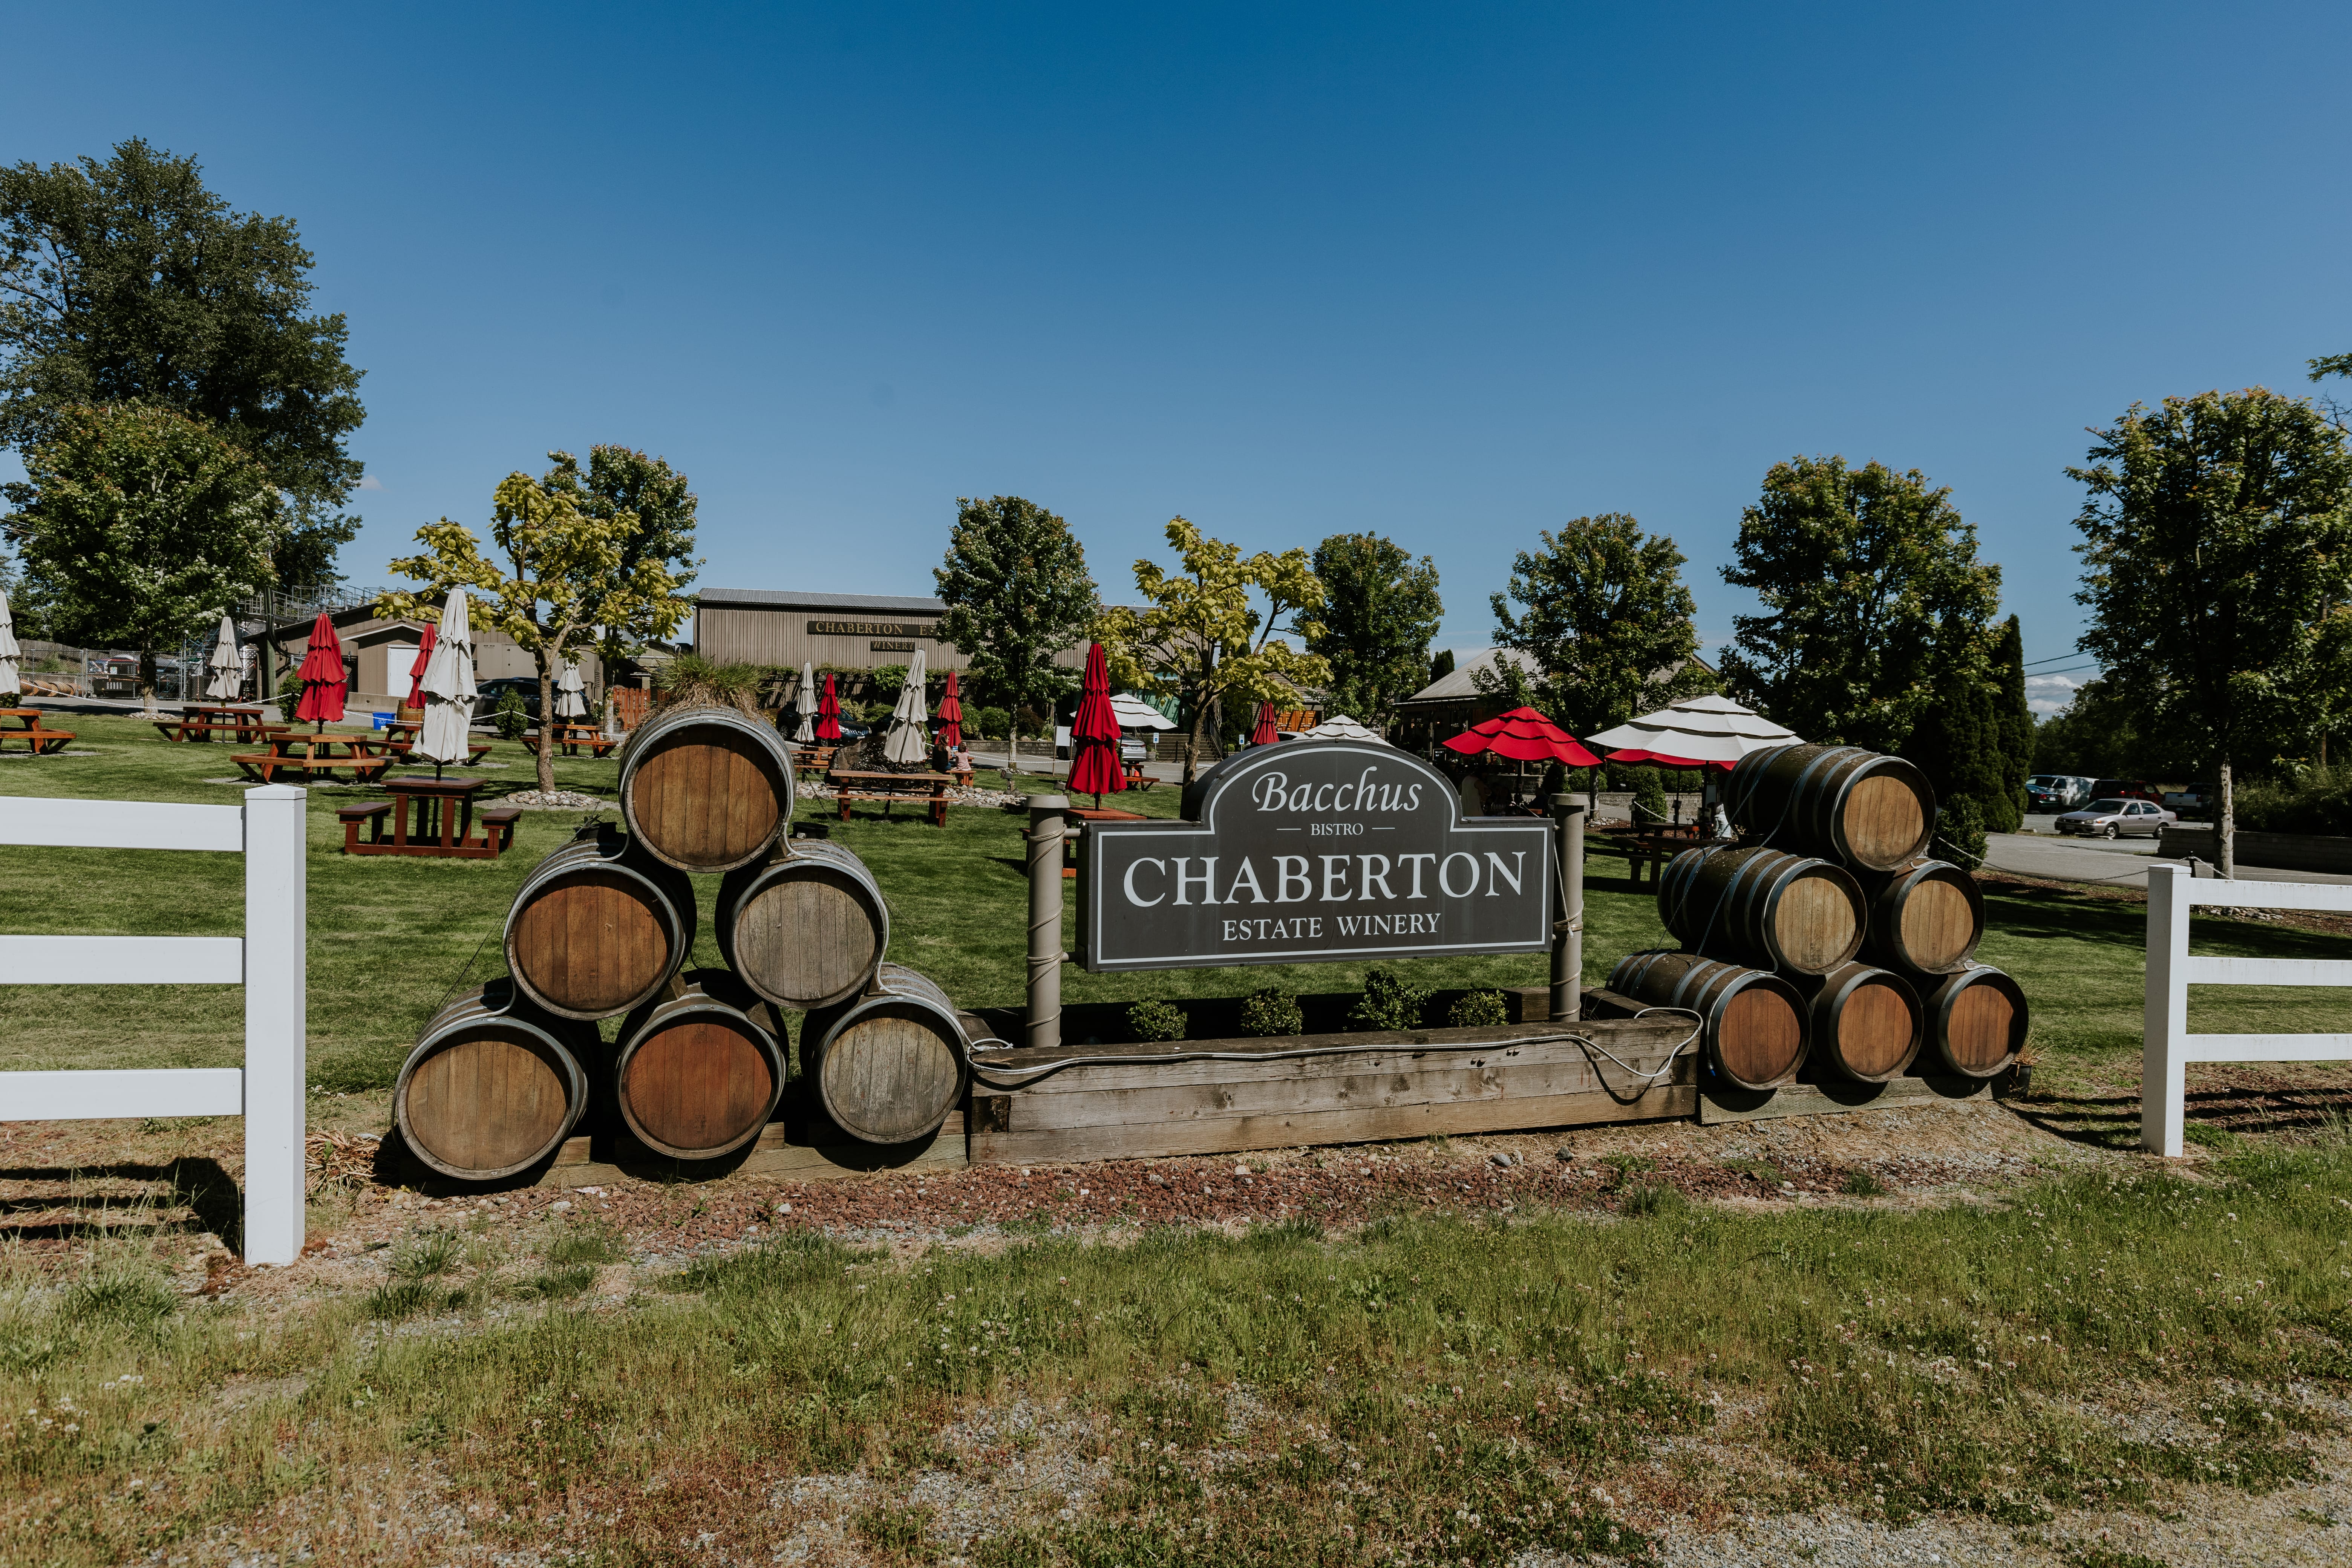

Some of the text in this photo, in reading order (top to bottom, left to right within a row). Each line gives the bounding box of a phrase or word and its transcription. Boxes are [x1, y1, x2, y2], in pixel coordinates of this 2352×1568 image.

[816, 622, 942, 636] CHABERTON EST
[872, 641, 914, 650] WINERY
[1252, 766, 1422, 812] Bacchus
[1311, 823, 1363, 836] BISTRO
[1124, 851, 1526, 907] CHABERTON
[1222, 913, 1441, 941] ESTATE WINERY
